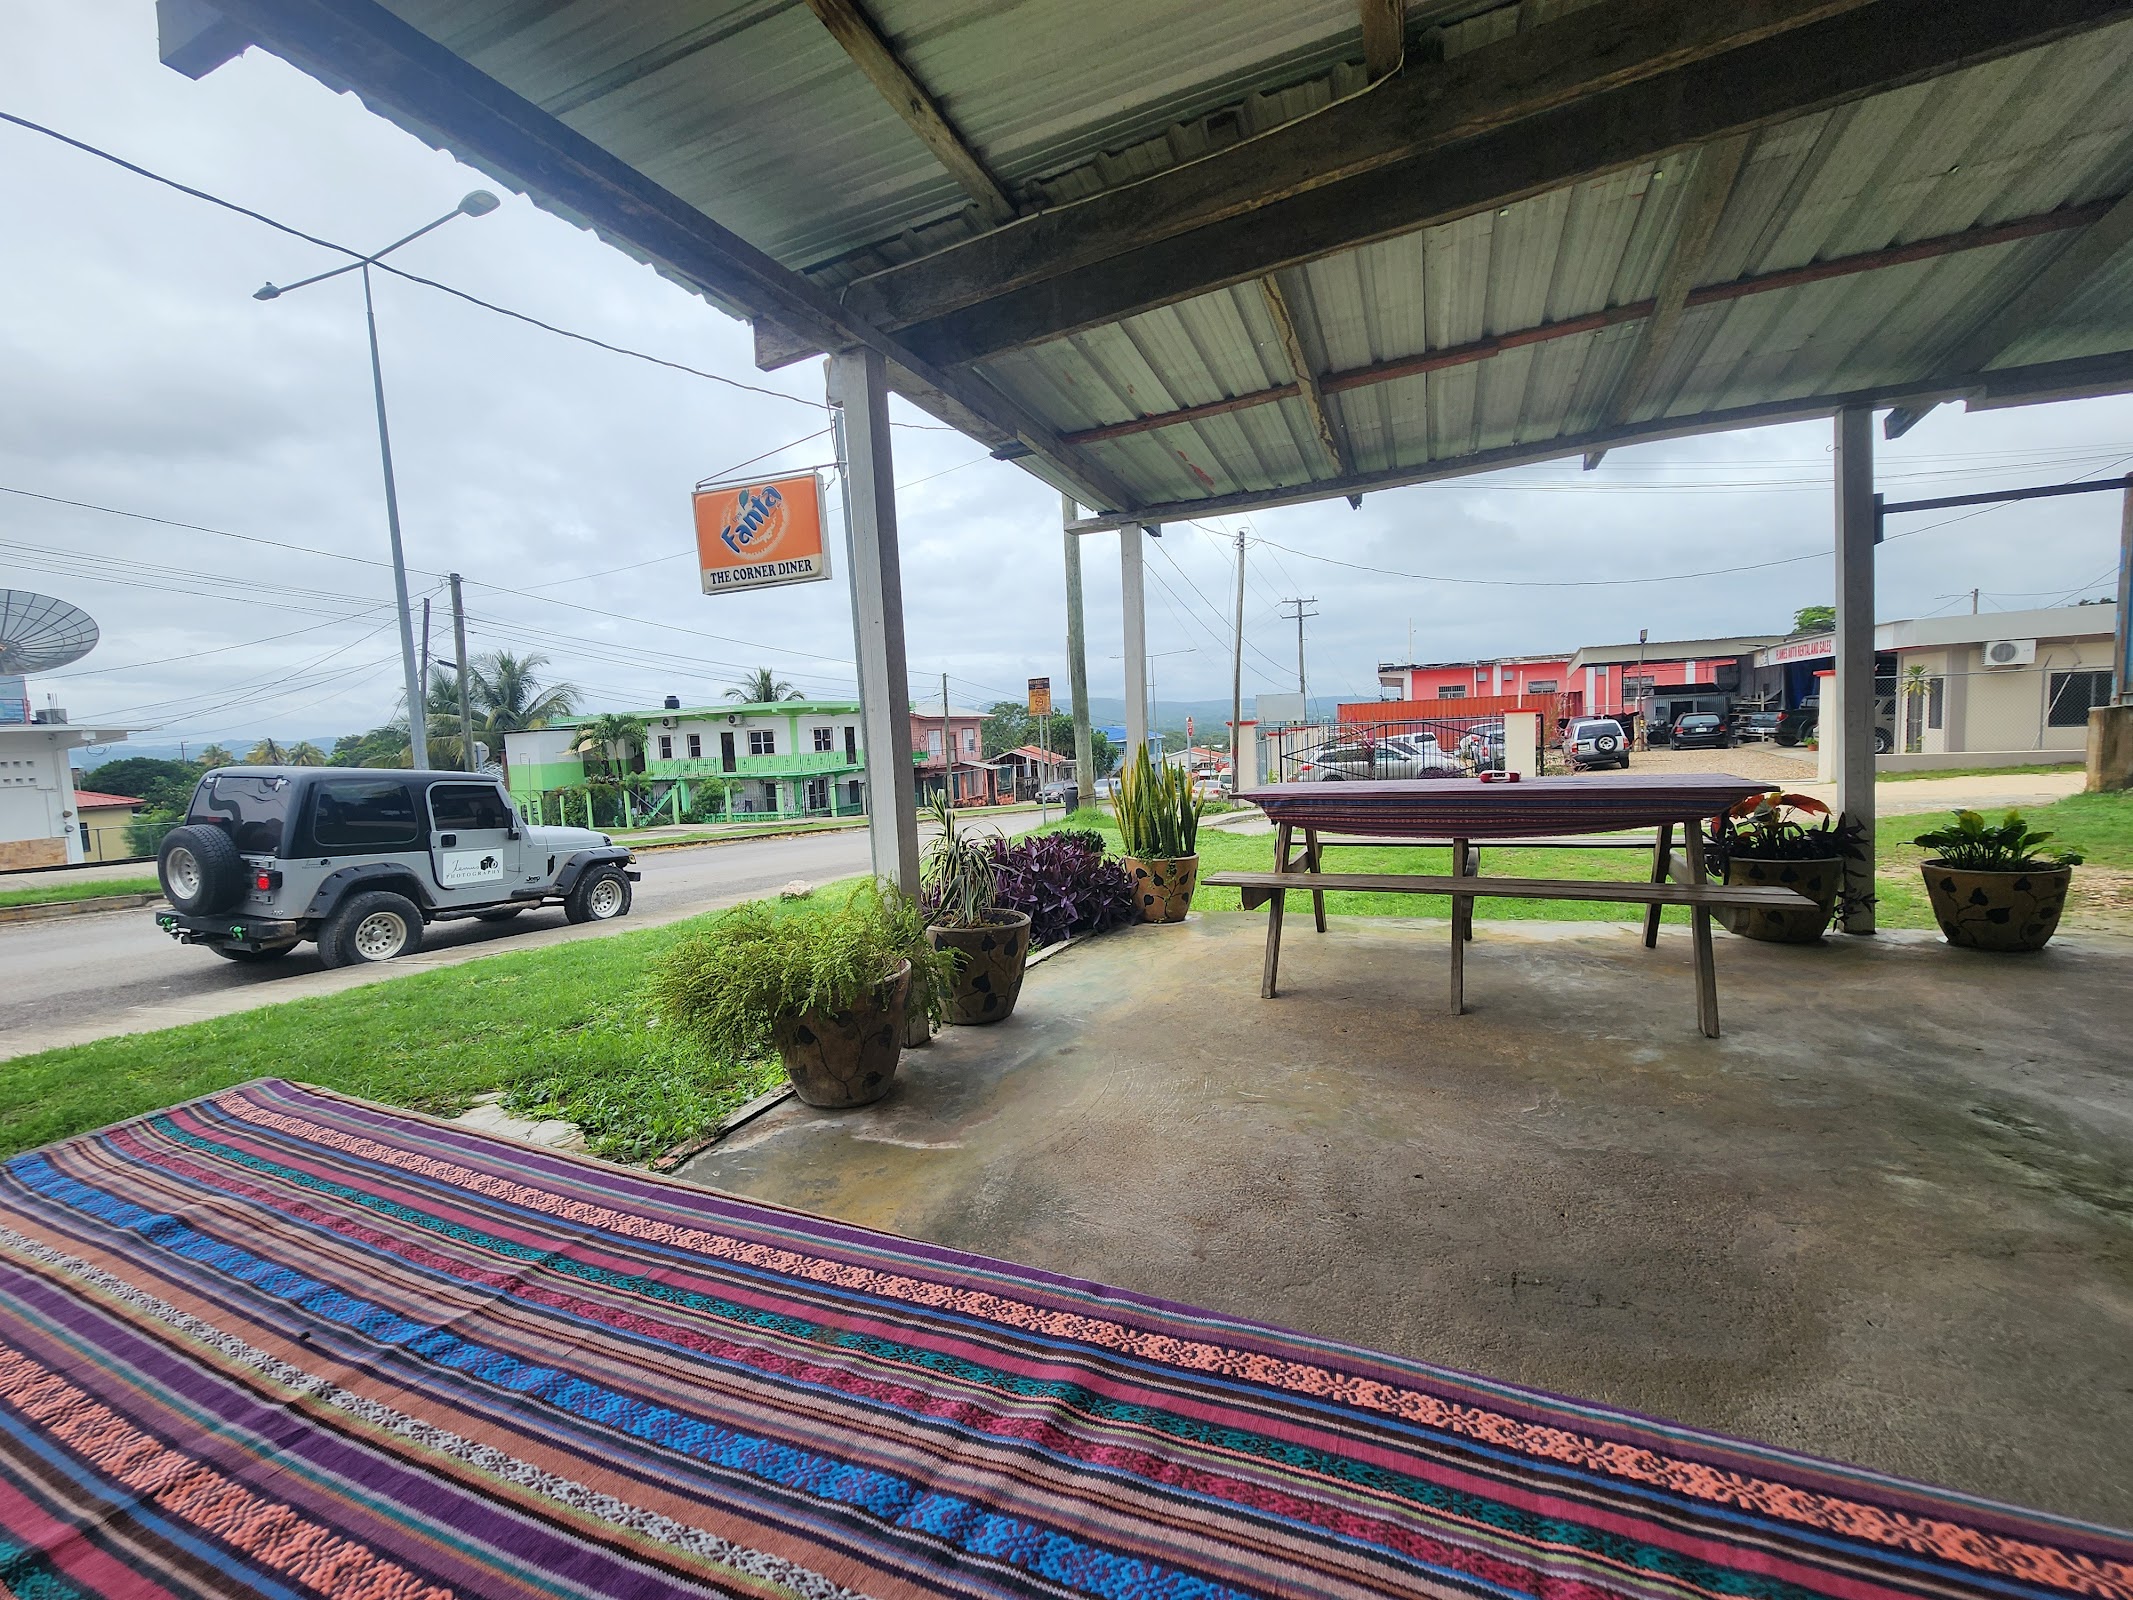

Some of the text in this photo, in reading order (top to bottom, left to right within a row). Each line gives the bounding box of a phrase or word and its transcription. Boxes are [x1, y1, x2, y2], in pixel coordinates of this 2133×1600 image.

[720, 485, 782, 554] Fanta
[710, 559, 812, 584] THE CORNER DINER
[1797, 644, 1810, 656] RENTAL
[1819, 639, 1831, 653] SALES
[446, 869, 500, 879] PHOTOGRAPHY
